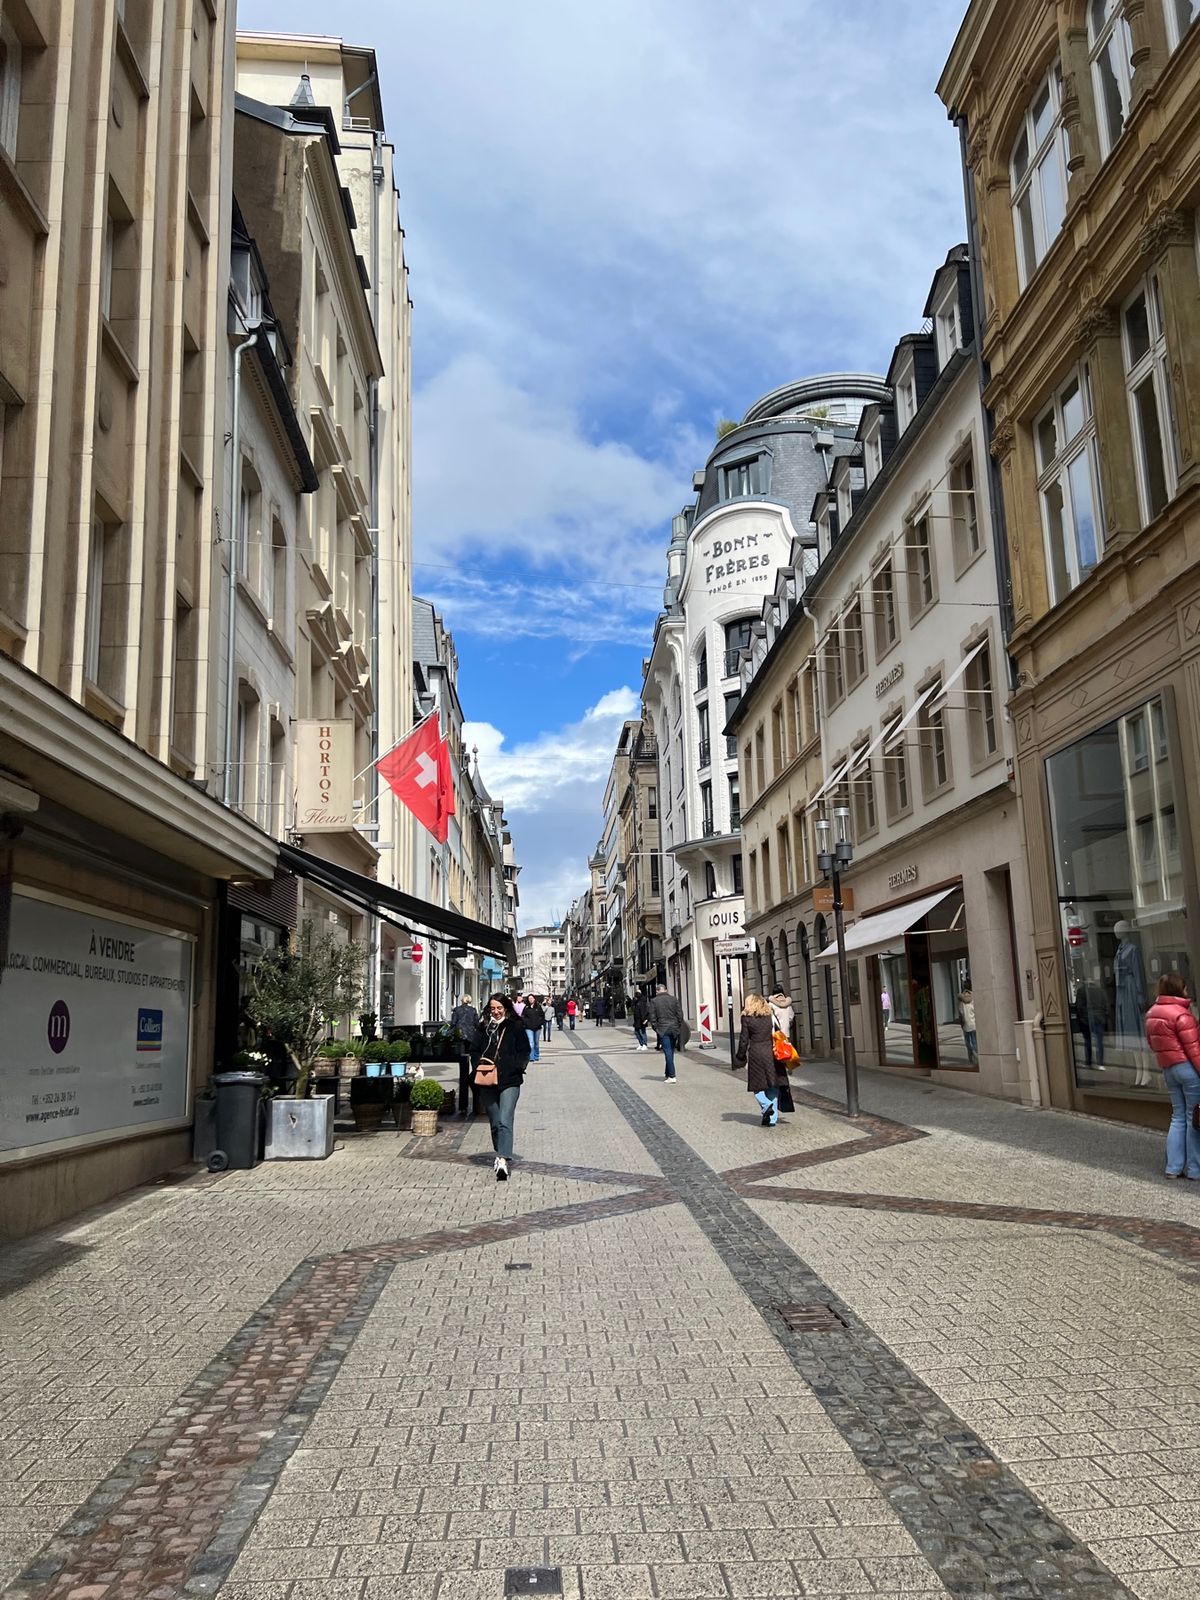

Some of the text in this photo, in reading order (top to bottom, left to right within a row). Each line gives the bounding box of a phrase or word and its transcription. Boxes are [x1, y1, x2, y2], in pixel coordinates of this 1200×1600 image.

[713, 534, 758, 558] BONN
[706, 554, 770, 583] FRÈRES
[736, 578, 746, 586] EN
[319, 727, 331, 803] HORTOS
[301, 808, 347, 824] Fleurs
[709, 912, 738, 926] LOUIS
[89, 929, 135, 962] À VENDRE
[33, 956, 83, 980] COMMERCIAL,
[85, 964, 115, 983] BUREAUX,
[117, 969, 141, 985] STUDIOS
[142, 974, 149, 986] ET
[51, 1015, 67, 1038] m
[140, 1017, 161, 1032] Colliers
